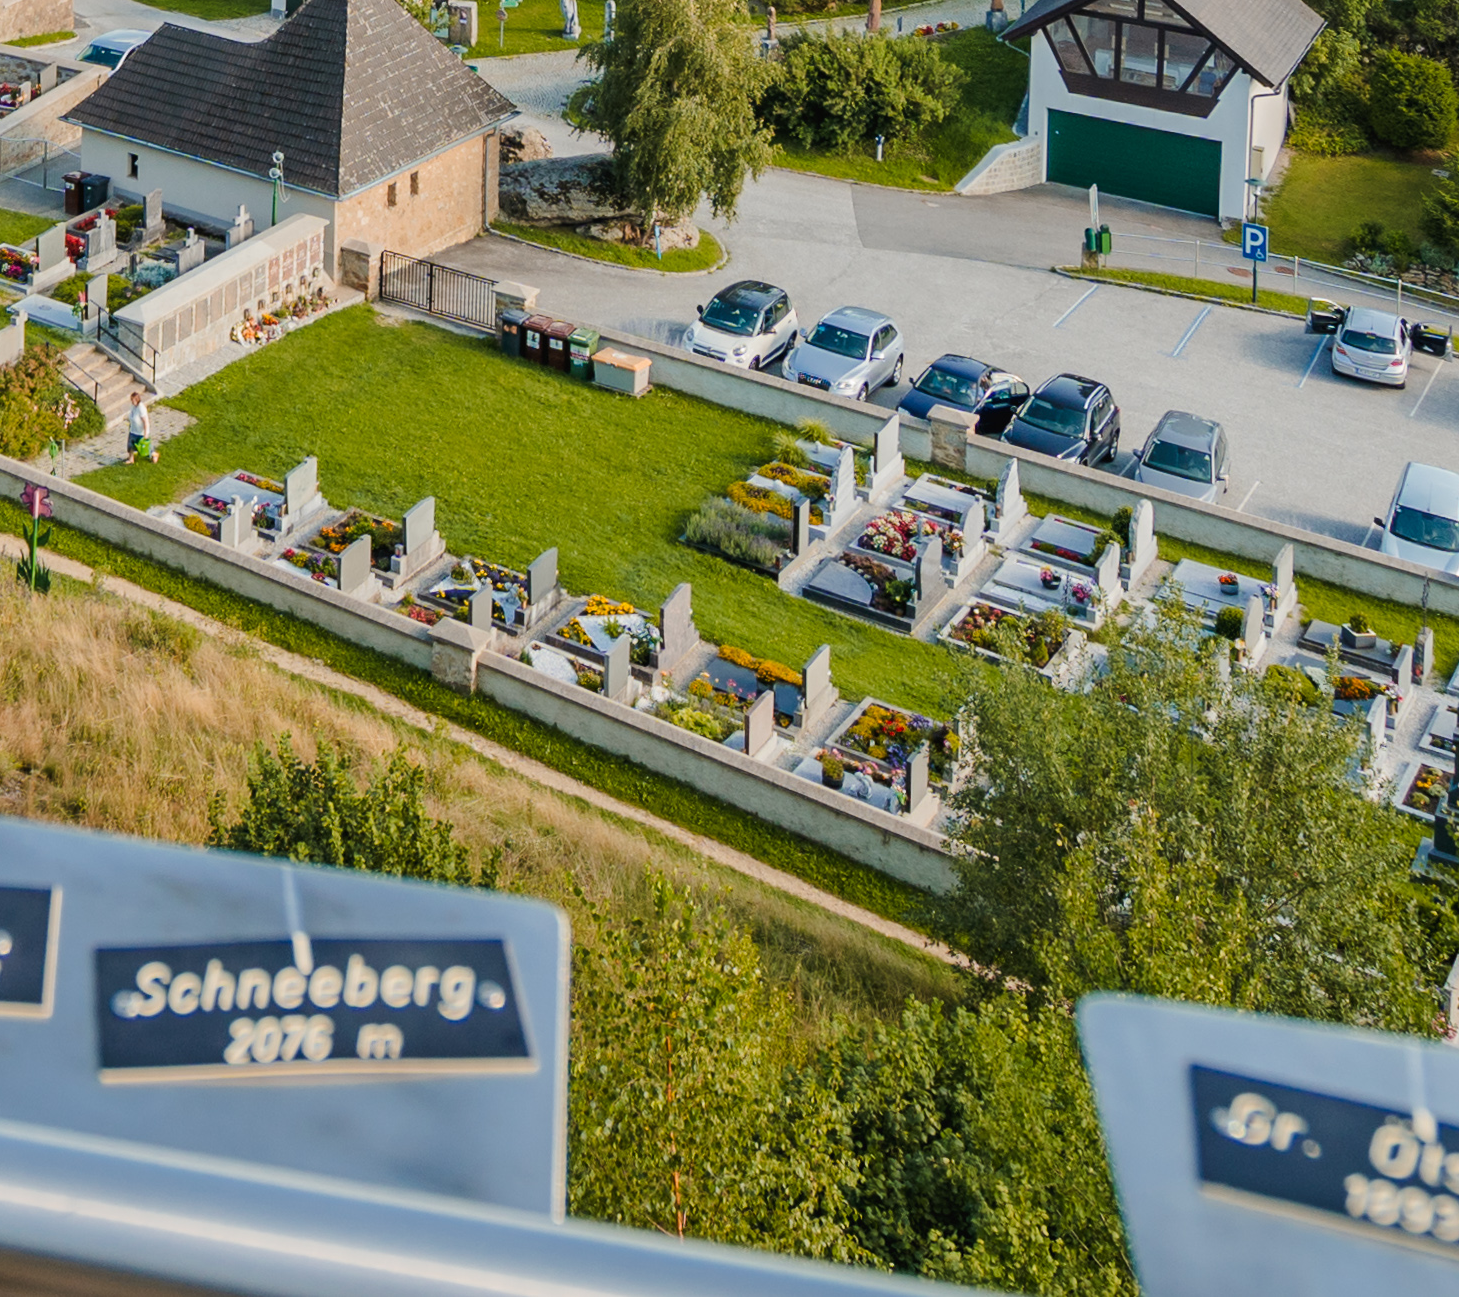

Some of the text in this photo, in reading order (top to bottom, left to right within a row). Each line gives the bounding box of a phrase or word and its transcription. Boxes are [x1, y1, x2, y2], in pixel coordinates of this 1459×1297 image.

[1245, 227, 1264, 254] P
[134, 955, 477, 1020] Schneeberg
[225, 1015, 404, 1065] 2076 m
[1228, 1092, 1322, 1159] Gr.
